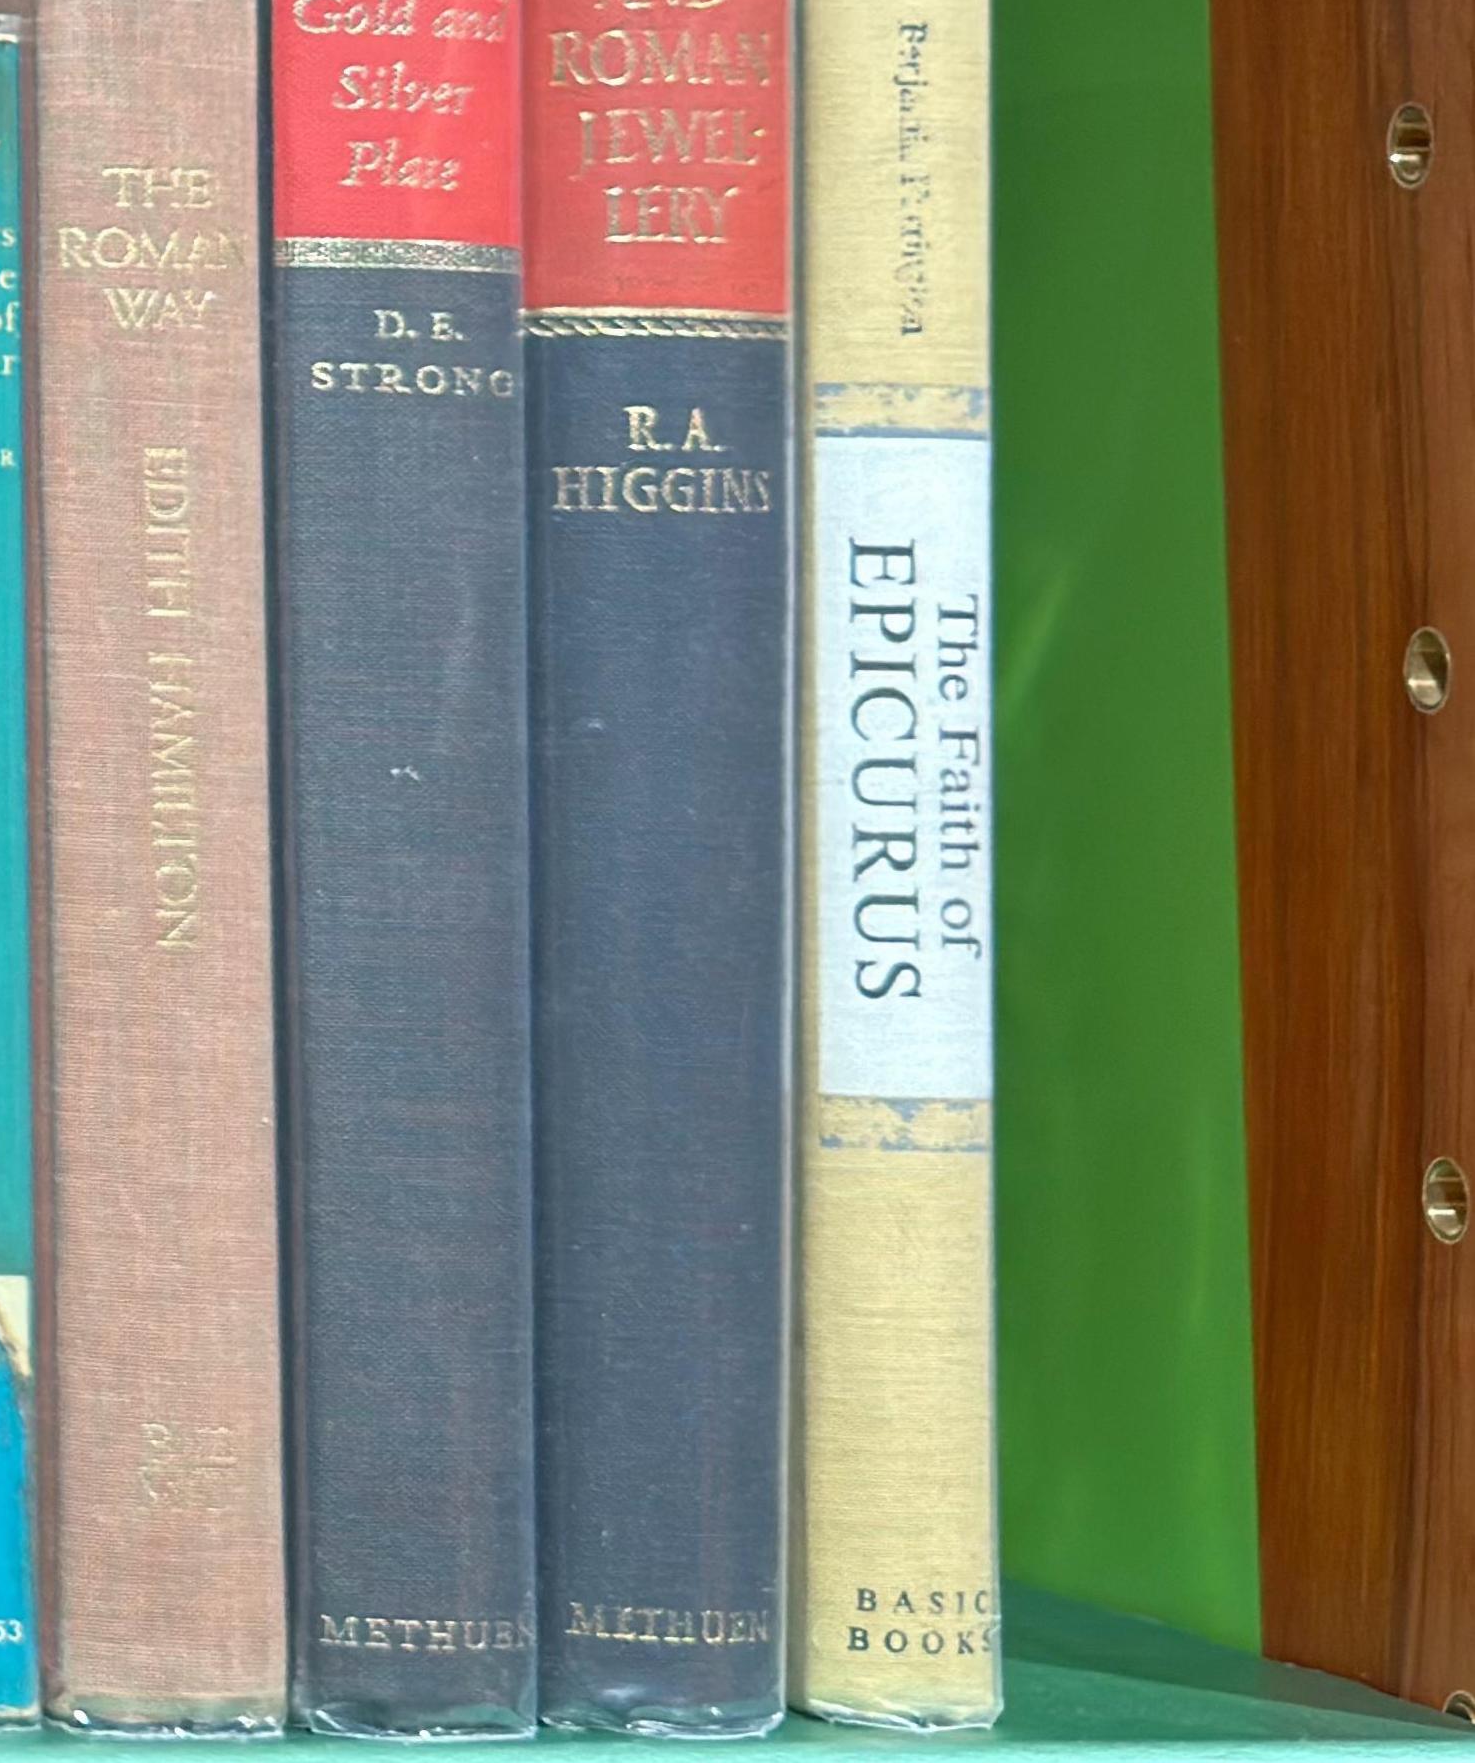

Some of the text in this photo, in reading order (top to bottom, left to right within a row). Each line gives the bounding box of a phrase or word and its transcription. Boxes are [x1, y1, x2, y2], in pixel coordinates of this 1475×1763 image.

[548, 28, 771, 87] ROMAN
[332, 60, 475, 116] Silver
[102, 167, 213, 209] THE
[338, 137, 461, 192] Plate
[603, 185, 741, 244] LERY
[102, 288, 215, 330] WAY
[374, 309, 420, 339] D.
[310, 361, 515, 398] STRONG
[552, 466, 772, 514] HIGGINS
[143, 447, 199, 949] EDITH HAMILTON
[848, 537, 924, 1002] EPICURUS
[937, 593, 982, 959] The Faith of
[565, 1601, 770, 1644] METHUEN
[856, 1588, 989, 1614] BASIC
